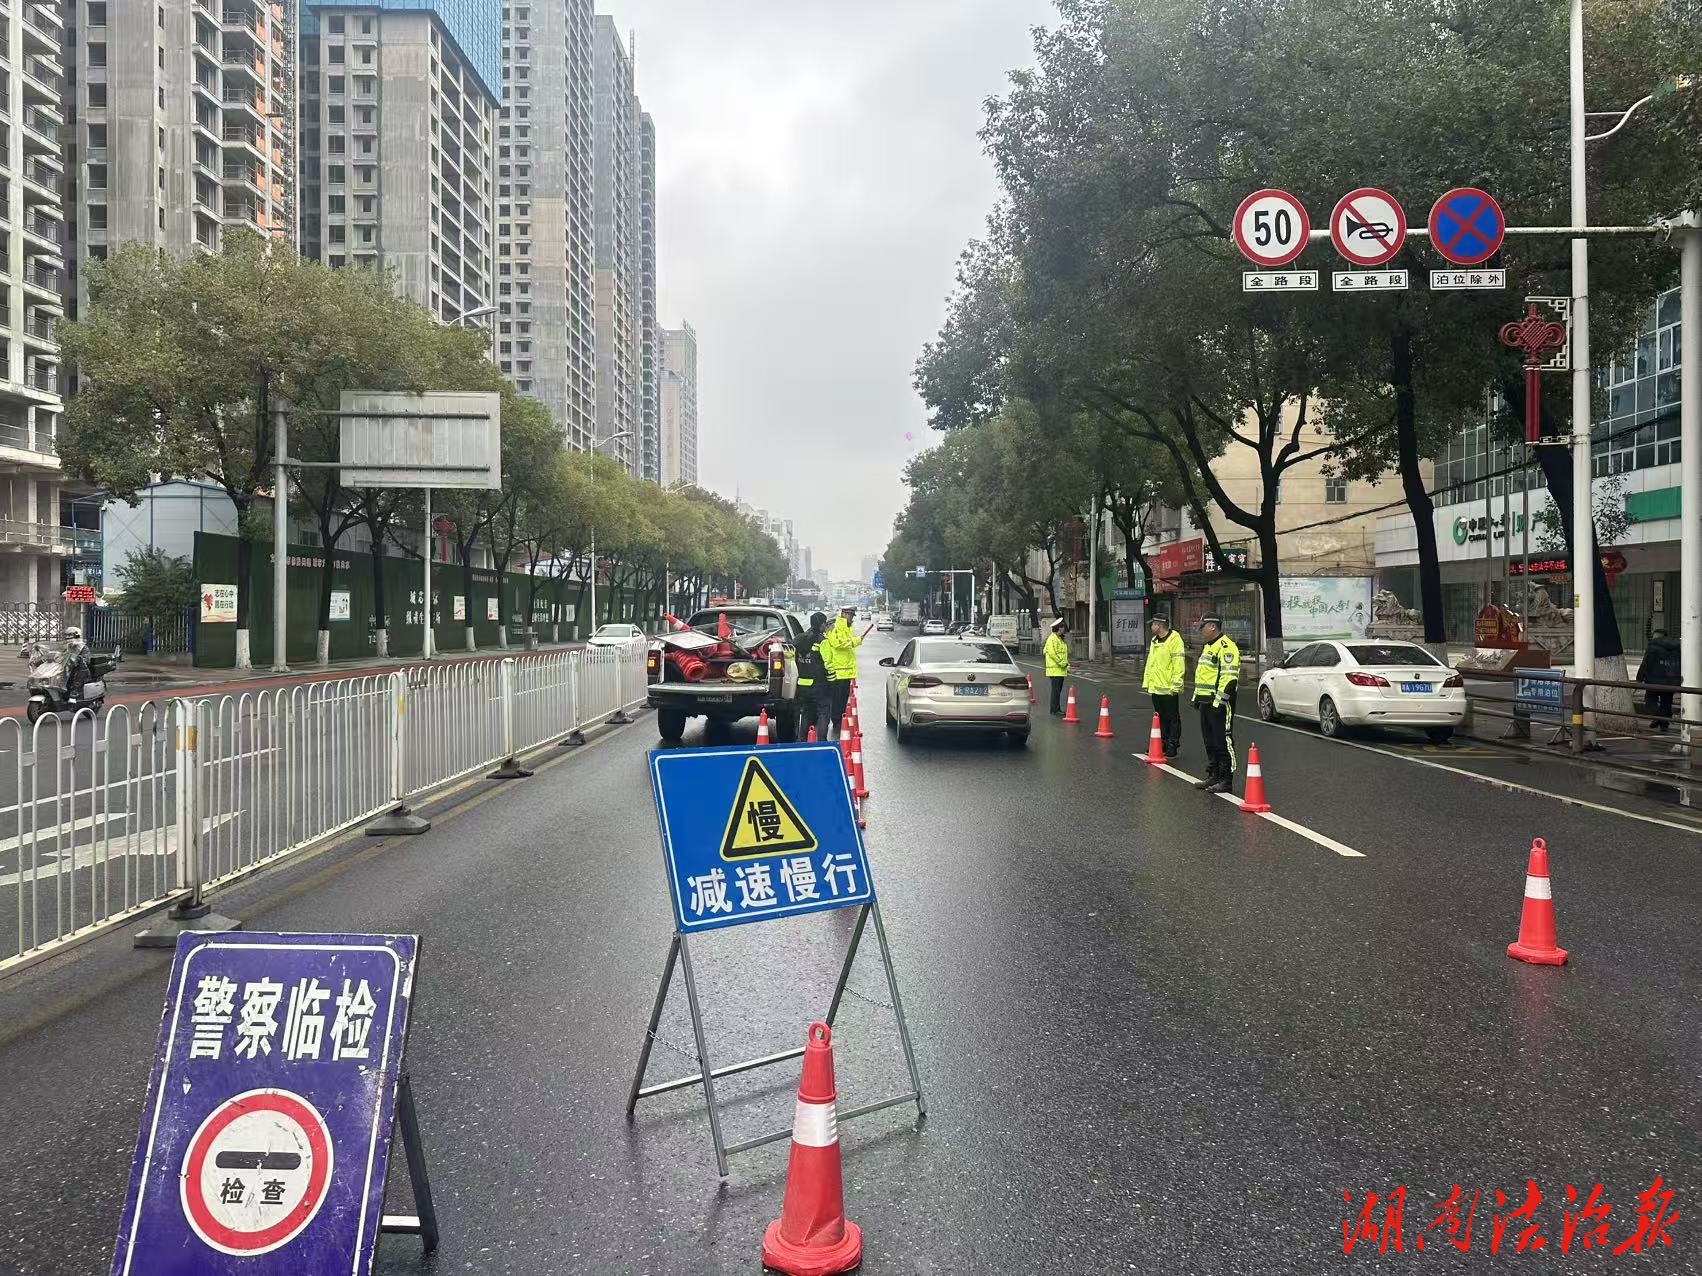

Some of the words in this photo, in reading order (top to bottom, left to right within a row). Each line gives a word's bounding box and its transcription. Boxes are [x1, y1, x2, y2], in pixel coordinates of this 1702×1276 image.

[1254, 208, 1292, 246] 50
[1250, 275, 1313, 286] 全路段
[1340, 275, 1403, 286] 全路段
[1436, 274, 1500, 285] 泊位除外
[747, 800, 784, 843] 慢
[687, 852, 857, 916] 减速慢行
[189, 975, 377, 1062] 警察临检
[220, 1177, 286, 1206] 检查
